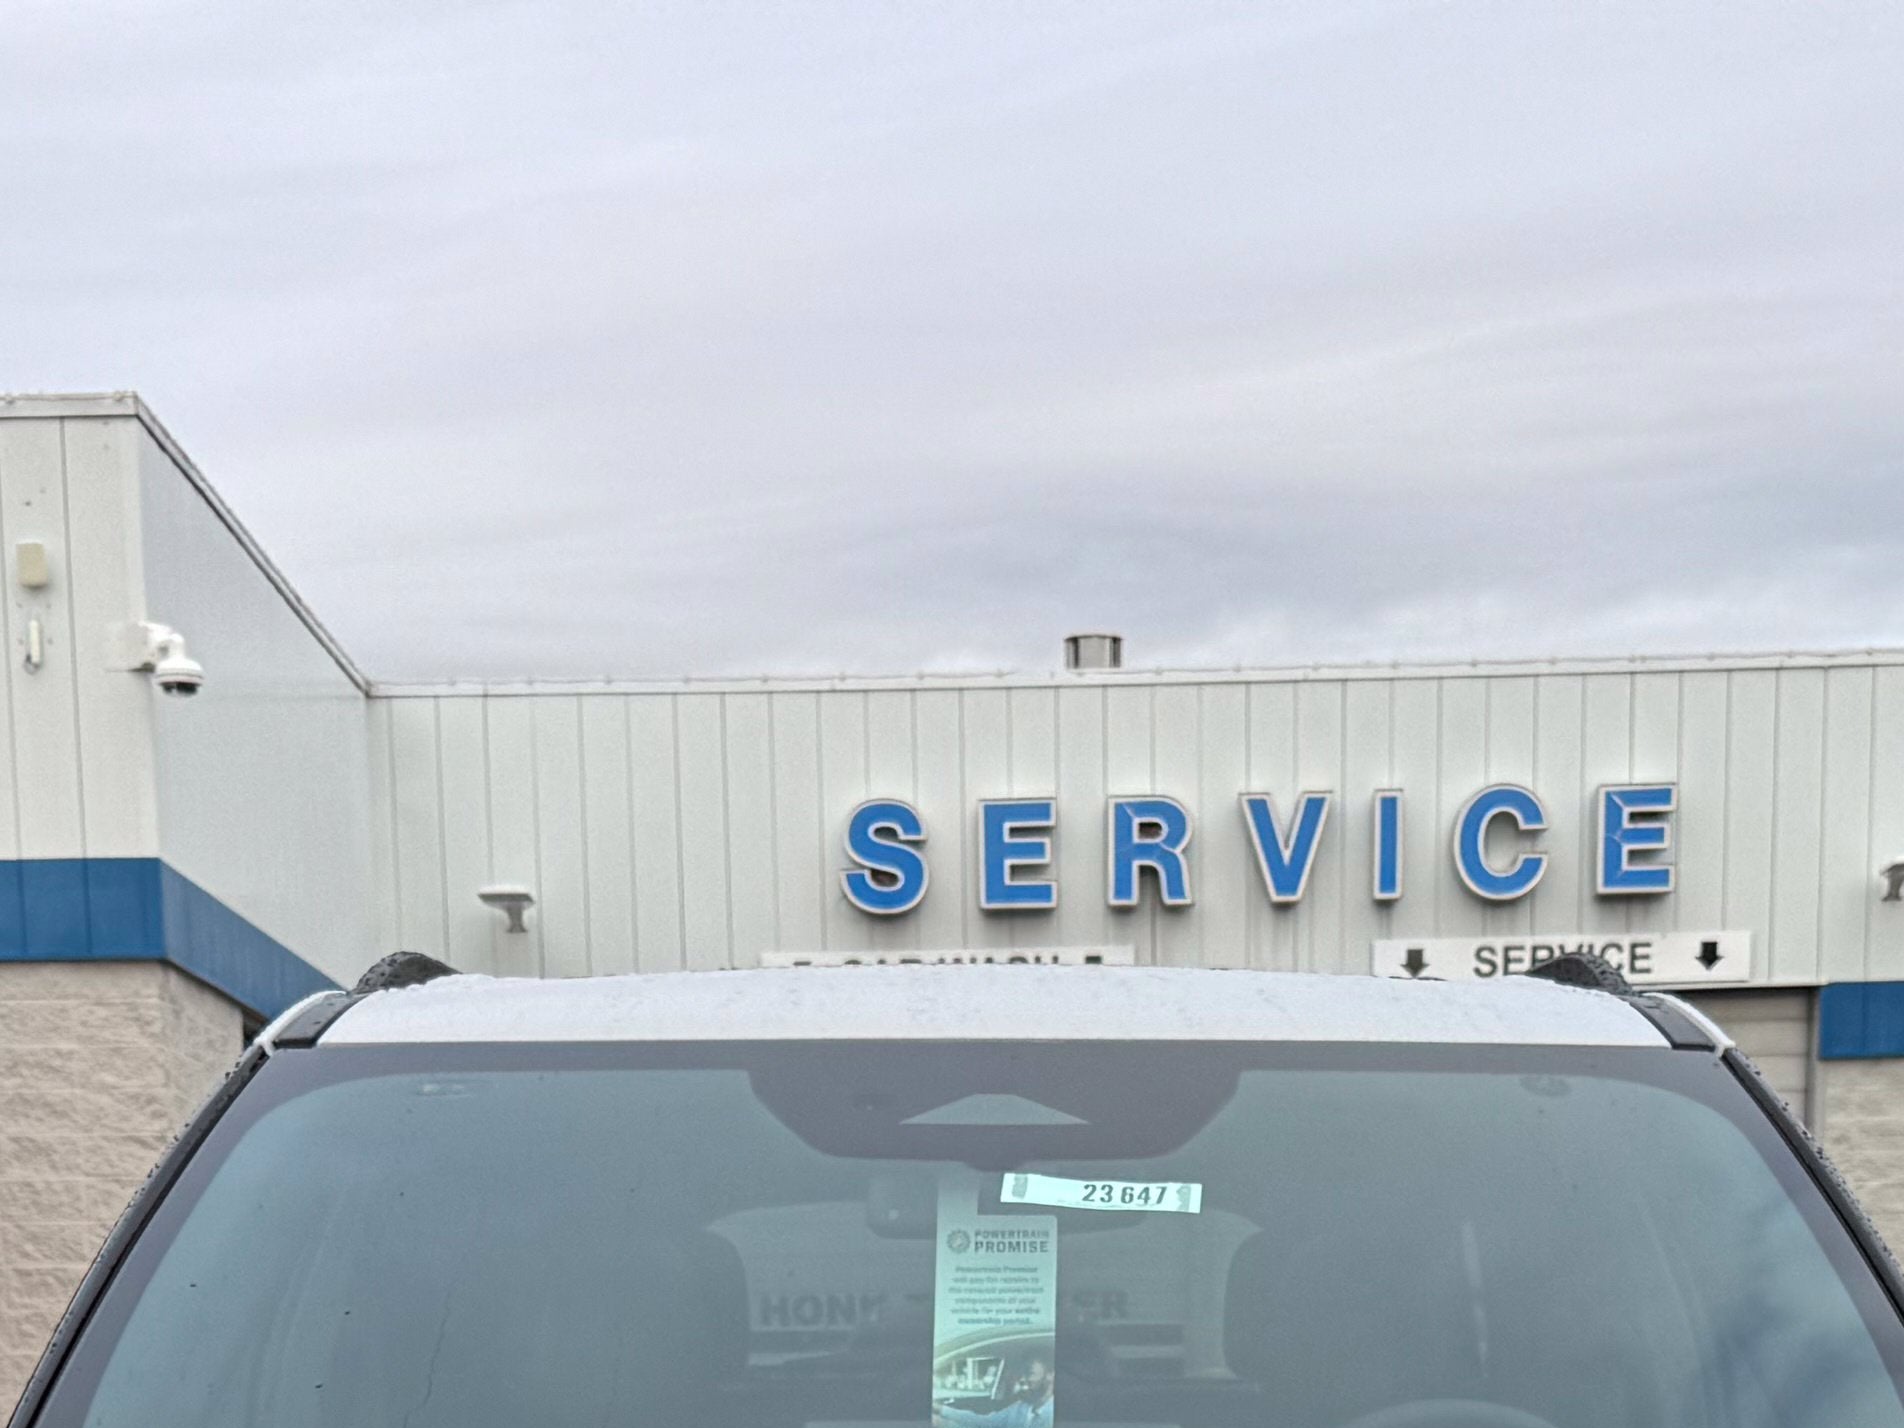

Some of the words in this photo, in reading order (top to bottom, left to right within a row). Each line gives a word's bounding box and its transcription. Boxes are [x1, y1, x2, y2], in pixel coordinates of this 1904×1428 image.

[841, 783, 1677, 913] SERVICE
[1473, 942, 1653, 978] SERCE
[1081, 1183, 1168, 1205] 23647
[974, 1241, 1049, 1253] PROMISE
